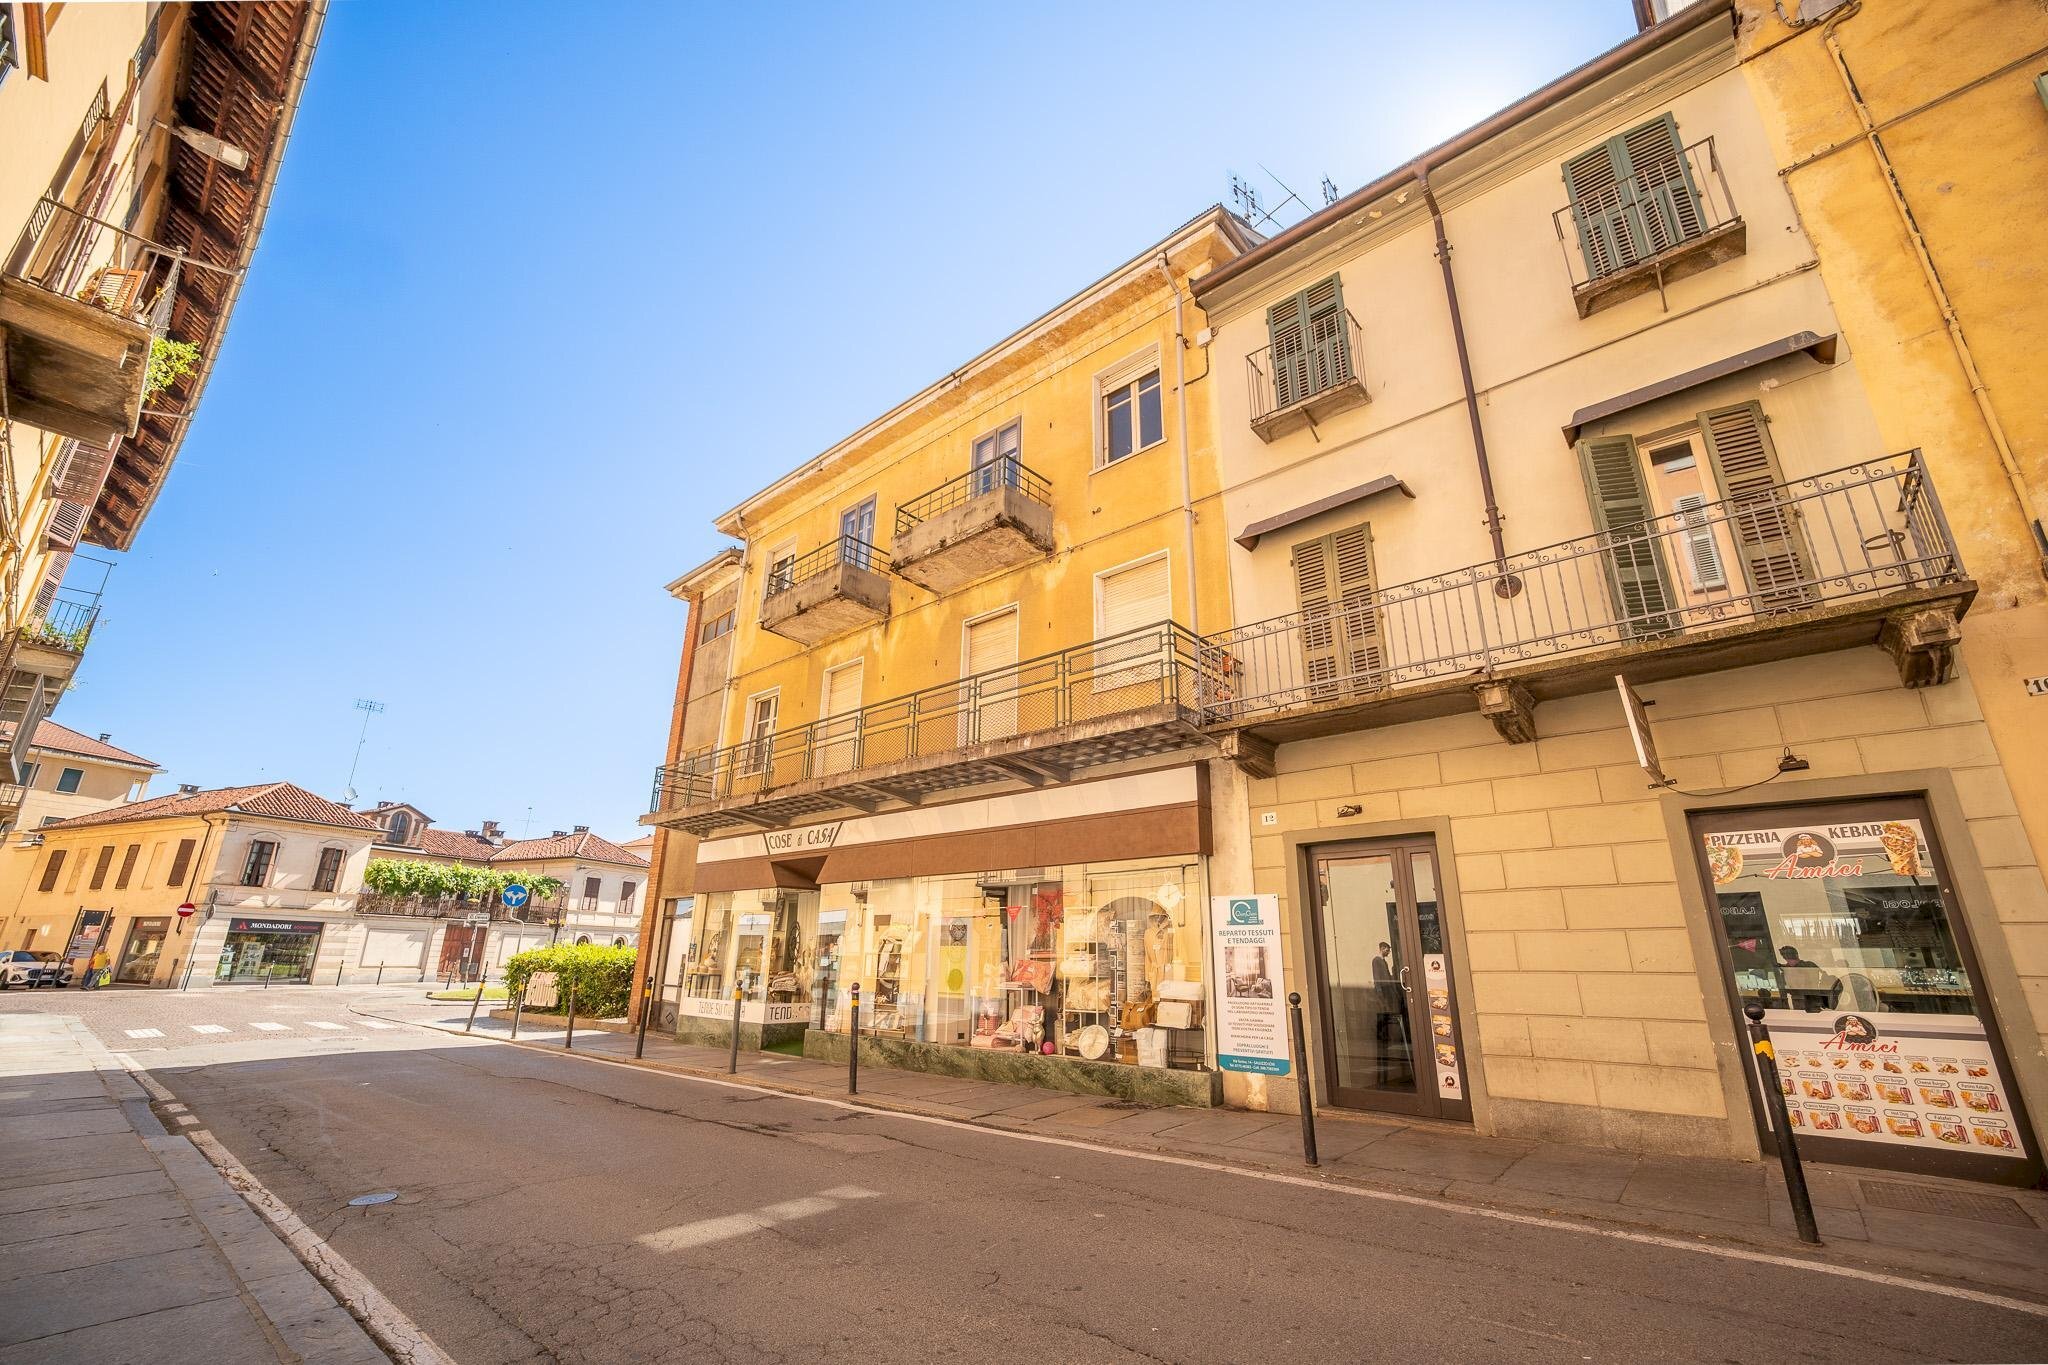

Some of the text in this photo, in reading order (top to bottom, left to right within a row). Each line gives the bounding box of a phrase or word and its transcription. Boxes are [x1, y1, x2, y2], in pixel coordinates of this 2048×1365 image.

[768, 834, 792, 850] COSE
[808, 827, 835, 845] CASA
[1711, 832, 1781, 846] PIZZERIA
[1828, 824, 1885, 839] KEBAB
[1764, 854, 1863, 880] Amici
[1819, 1031, 1898, 1053] Amici
